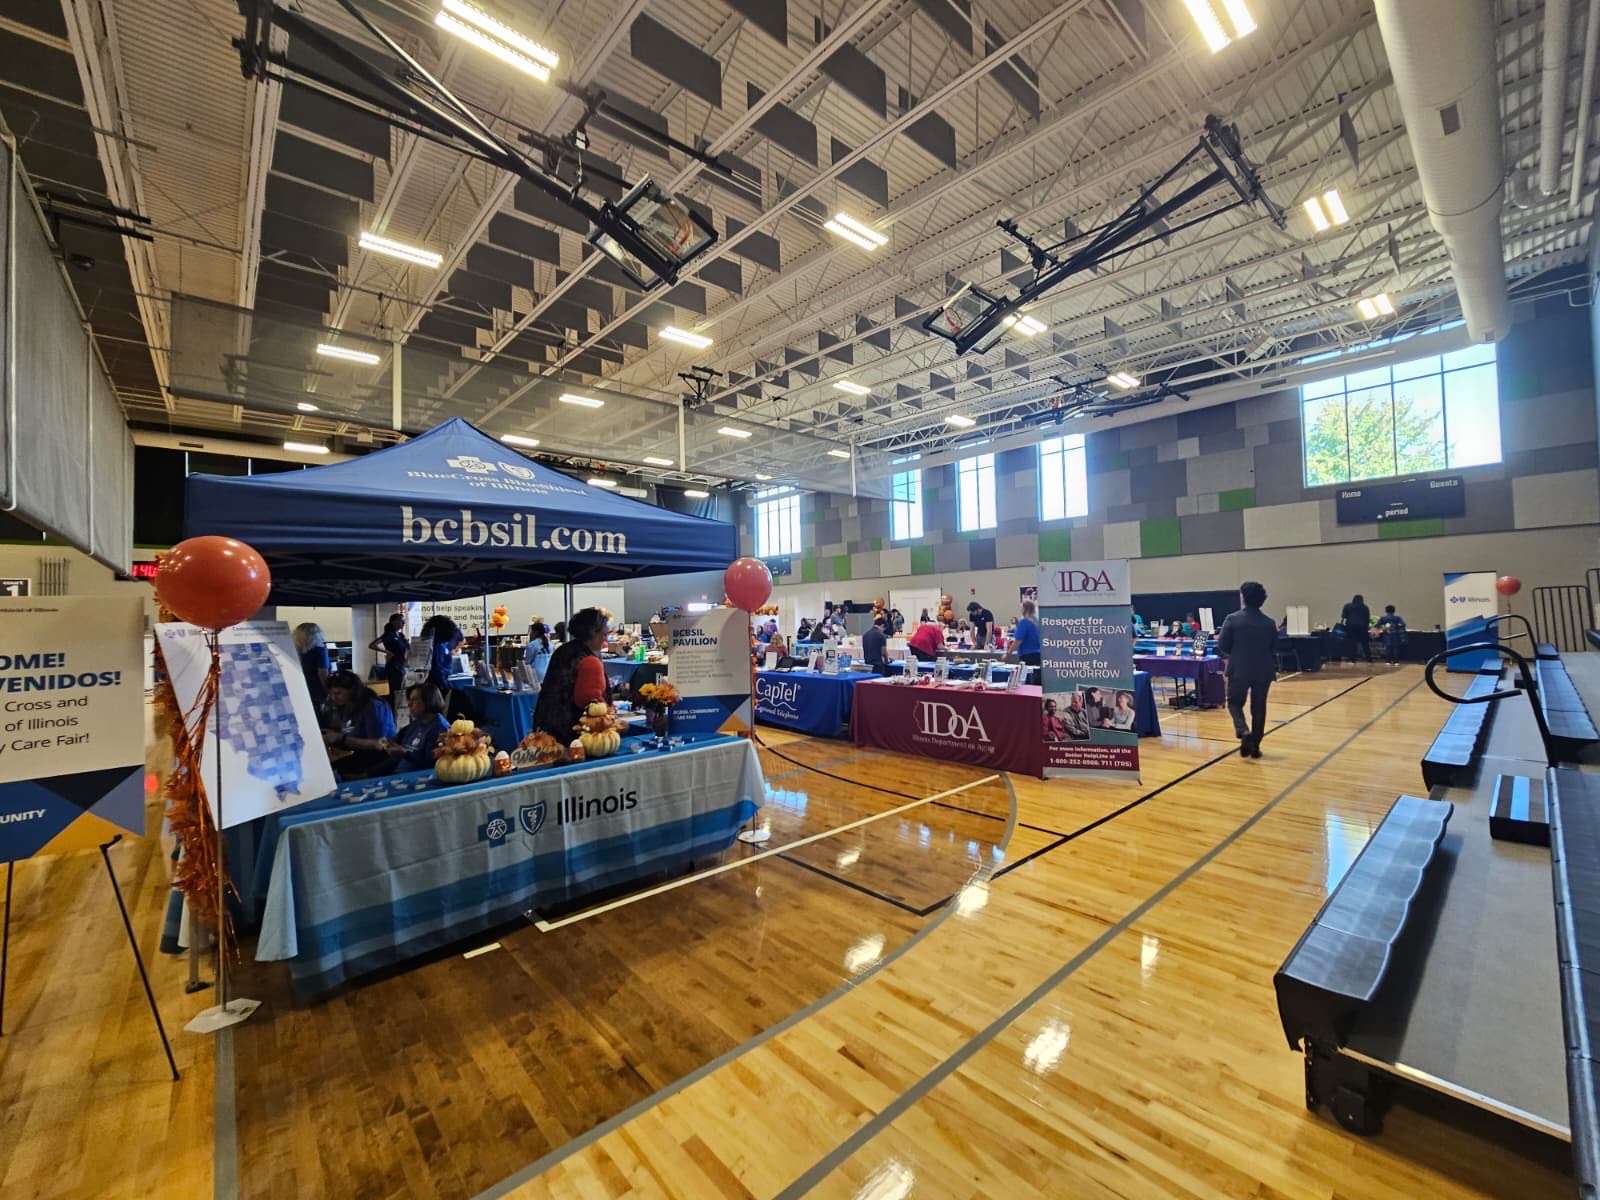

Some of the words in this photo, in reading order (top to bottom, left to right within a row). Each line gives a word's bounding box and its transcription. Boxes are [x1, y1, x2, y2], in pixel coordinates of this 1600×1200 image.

[401, 505, 628, 555] bcbsil.com
[1058, 569, 1116, 592] IDoA
[1041, 618, 1085, 627] Respect
[1088, 617, 1103, 625] for
[1066, 626, 1127, 635] YESTERDAY
[673, 637, 718, 647] PAVILION
[1042, 638, 1084, 648] Support
[1088, 638, 1103, 646] for
[1068, 647, 1101, 655] TODAY
[1042, 660, 1089, 670] Planning
[1092, 660, 1108, 668] for
[1056, 669, 1120, 678] TOMORROW
[5, 700, 52, 712] Cross
[57, 696, 88, 708] and
[5, 719, 24, 732] of
[28, 716, 79, 730] Illinois
[919, 701, 991, 742] IDoA
[11, 739, 51, 751] Care
[57, 733, 90, 747] Fair!
[556, 788, 638, 826] Illinois
